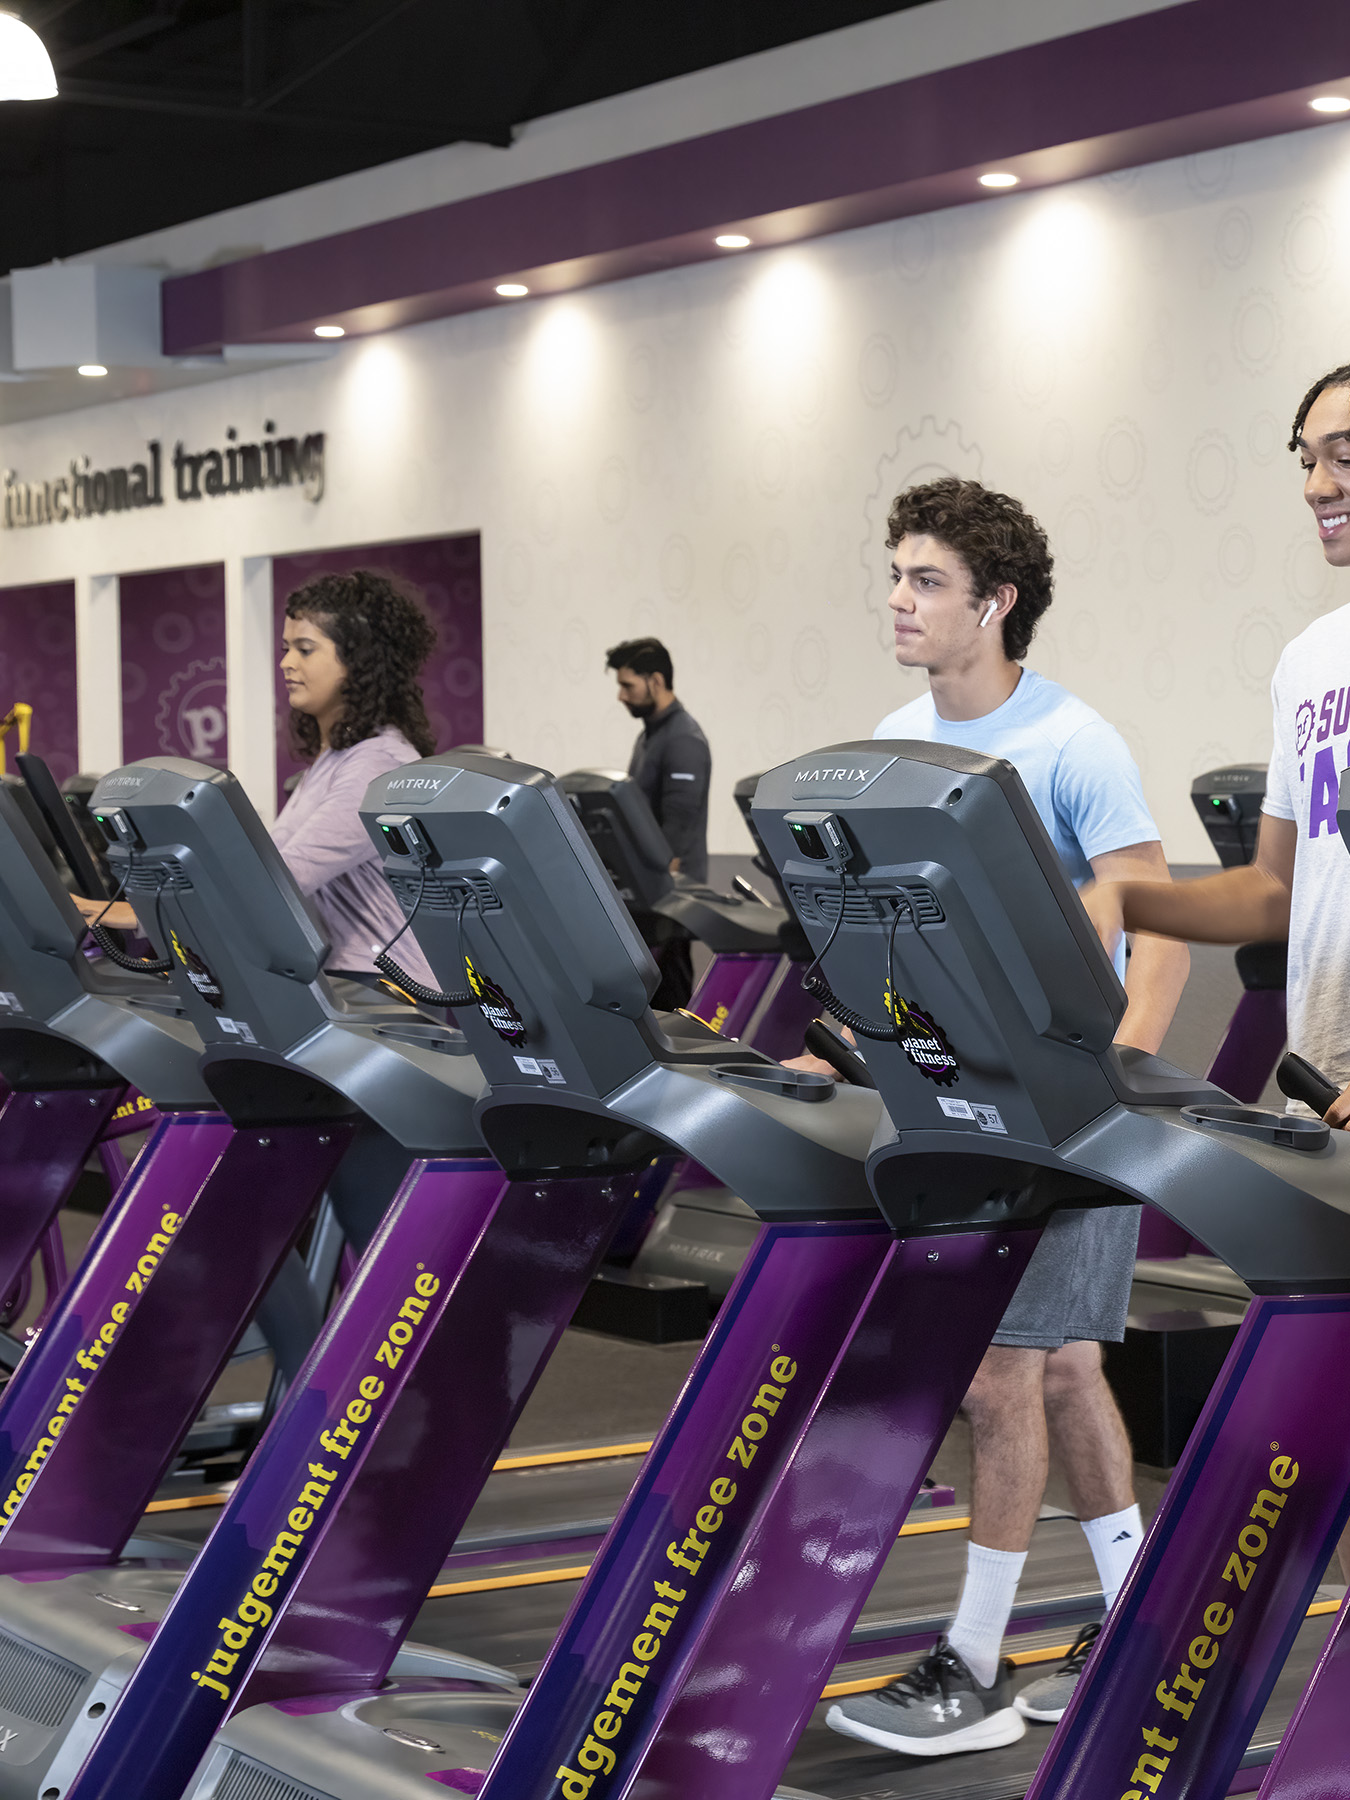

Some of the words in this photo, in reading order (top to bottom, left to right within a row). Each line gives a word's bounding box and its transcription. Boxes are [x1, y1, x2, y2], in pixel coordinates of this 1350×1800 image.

[2, 439, 163, 529] functional
[173, 418, 325, 506] training
[387, 778, 441, 790] MATRIX
[795, 768, 870, 783] MATRIX
[480, 1003, 512, 1018] planet
[489, 1015, 525, 1031] fitness
[902, 1036, 941, 1052] planet
[911, 1049, 957, 1067] fitness
[988, 1113, 998, 1125] 57
[76, 1301, 131, 1372] free
[666, 1476, 737, 1576] free
[191, 1462, 337, 1700] judgement
[320, 1375, 385, 1460] free
[1155, 1602, 1235, 1721] free
